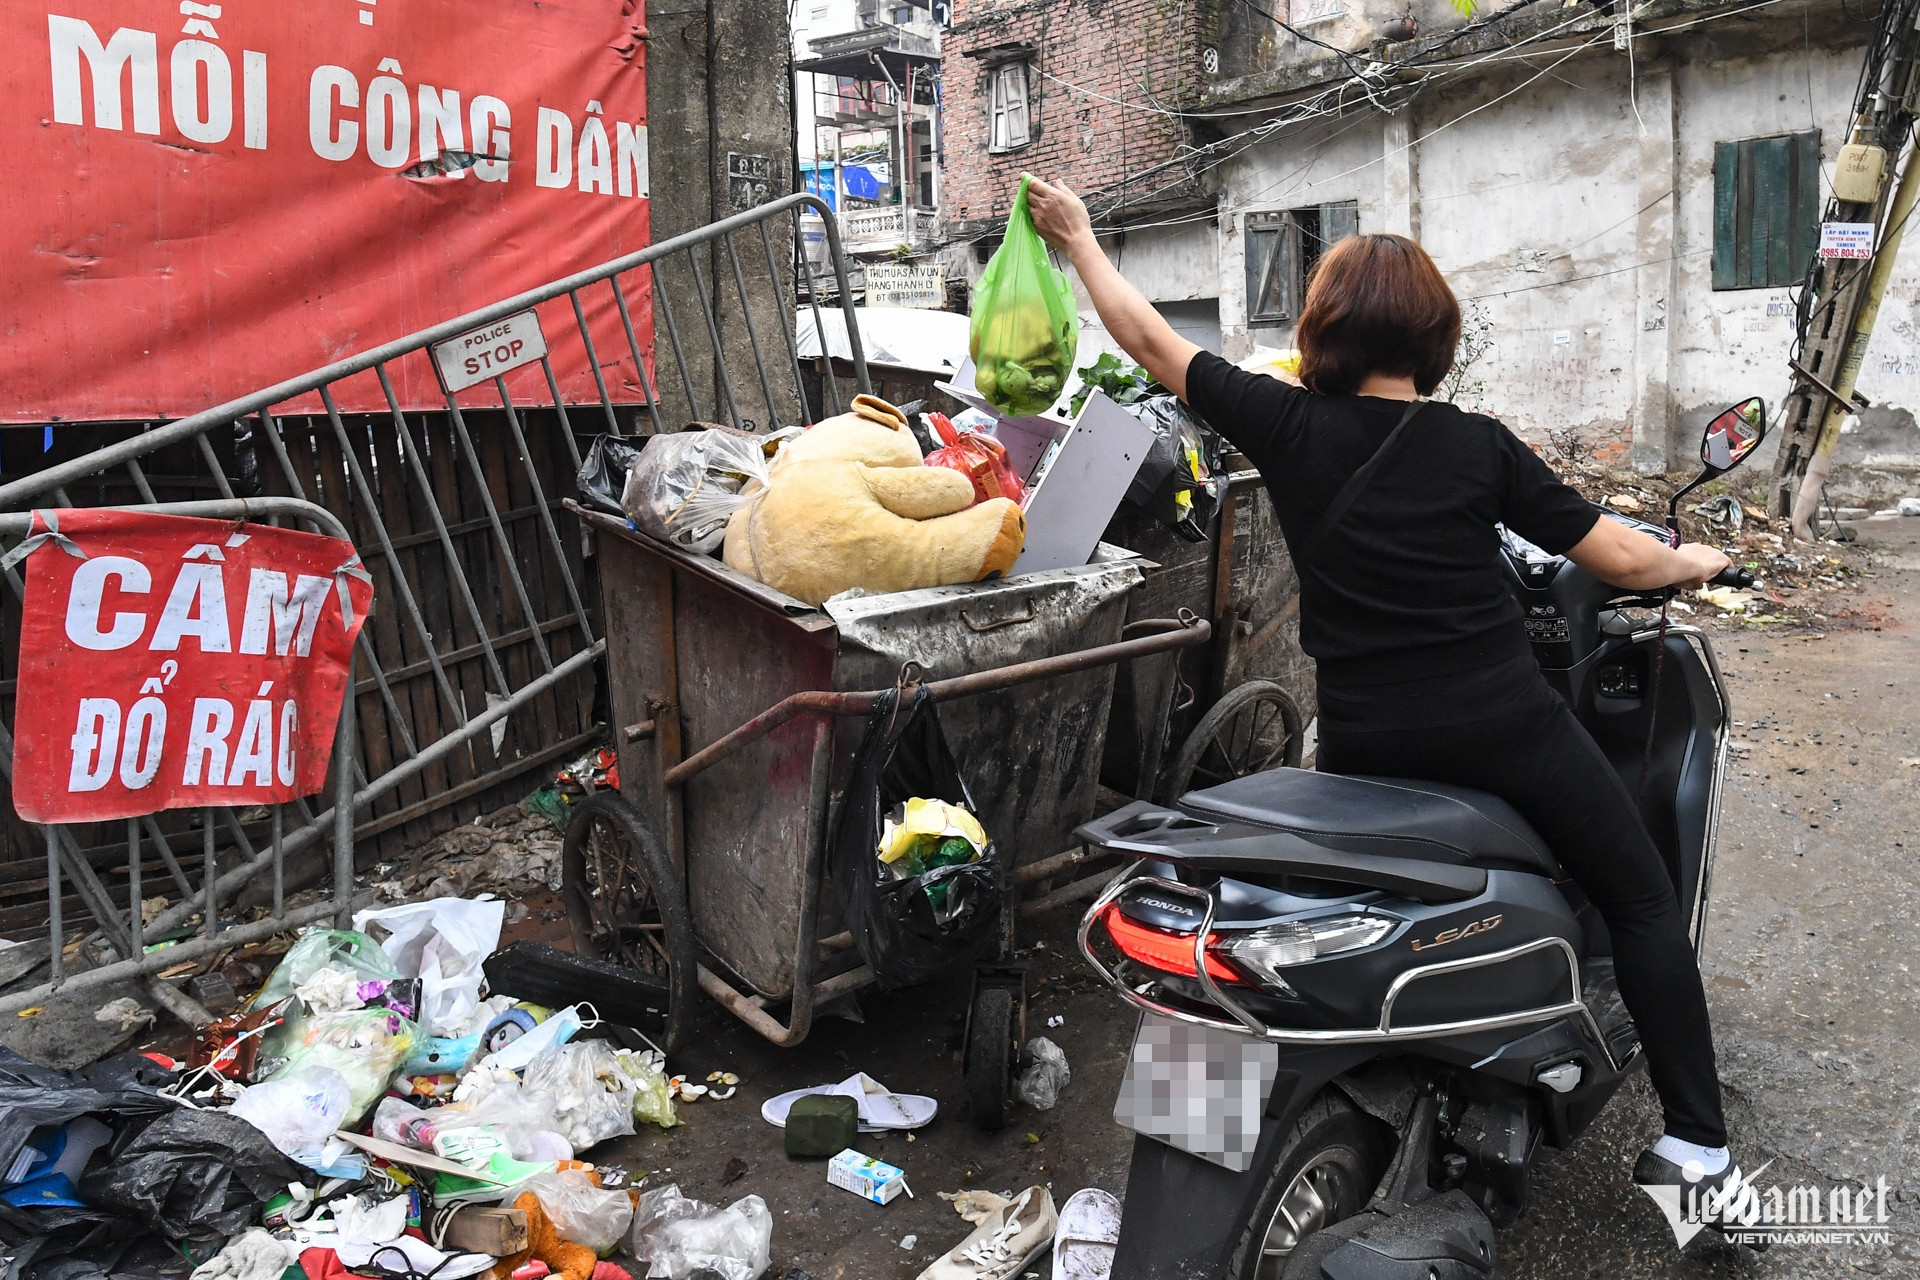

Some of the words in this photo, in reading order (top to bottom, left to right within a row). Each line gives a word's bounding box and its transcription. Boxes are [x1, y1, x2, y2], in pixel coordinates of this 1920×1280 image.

[48, 0, 267, 150] MỖI
[309, 57, 511, 183] CÔNG
[536, 100, 649, 199] DÂN
[1820, 248, 1870, 257] 0985.804.253
[464, 324, 511, 349] POLICE
[464, 339, 523, 375] STOP
[65, 534, 333, 657] CẤM
[68, 660, 178, 792] ĐỔ
[182, 681, 297, 787] RÁC
[1136, 896, 1194, 917] HONDA
[1411, 914, 1502, 951] LEAD
